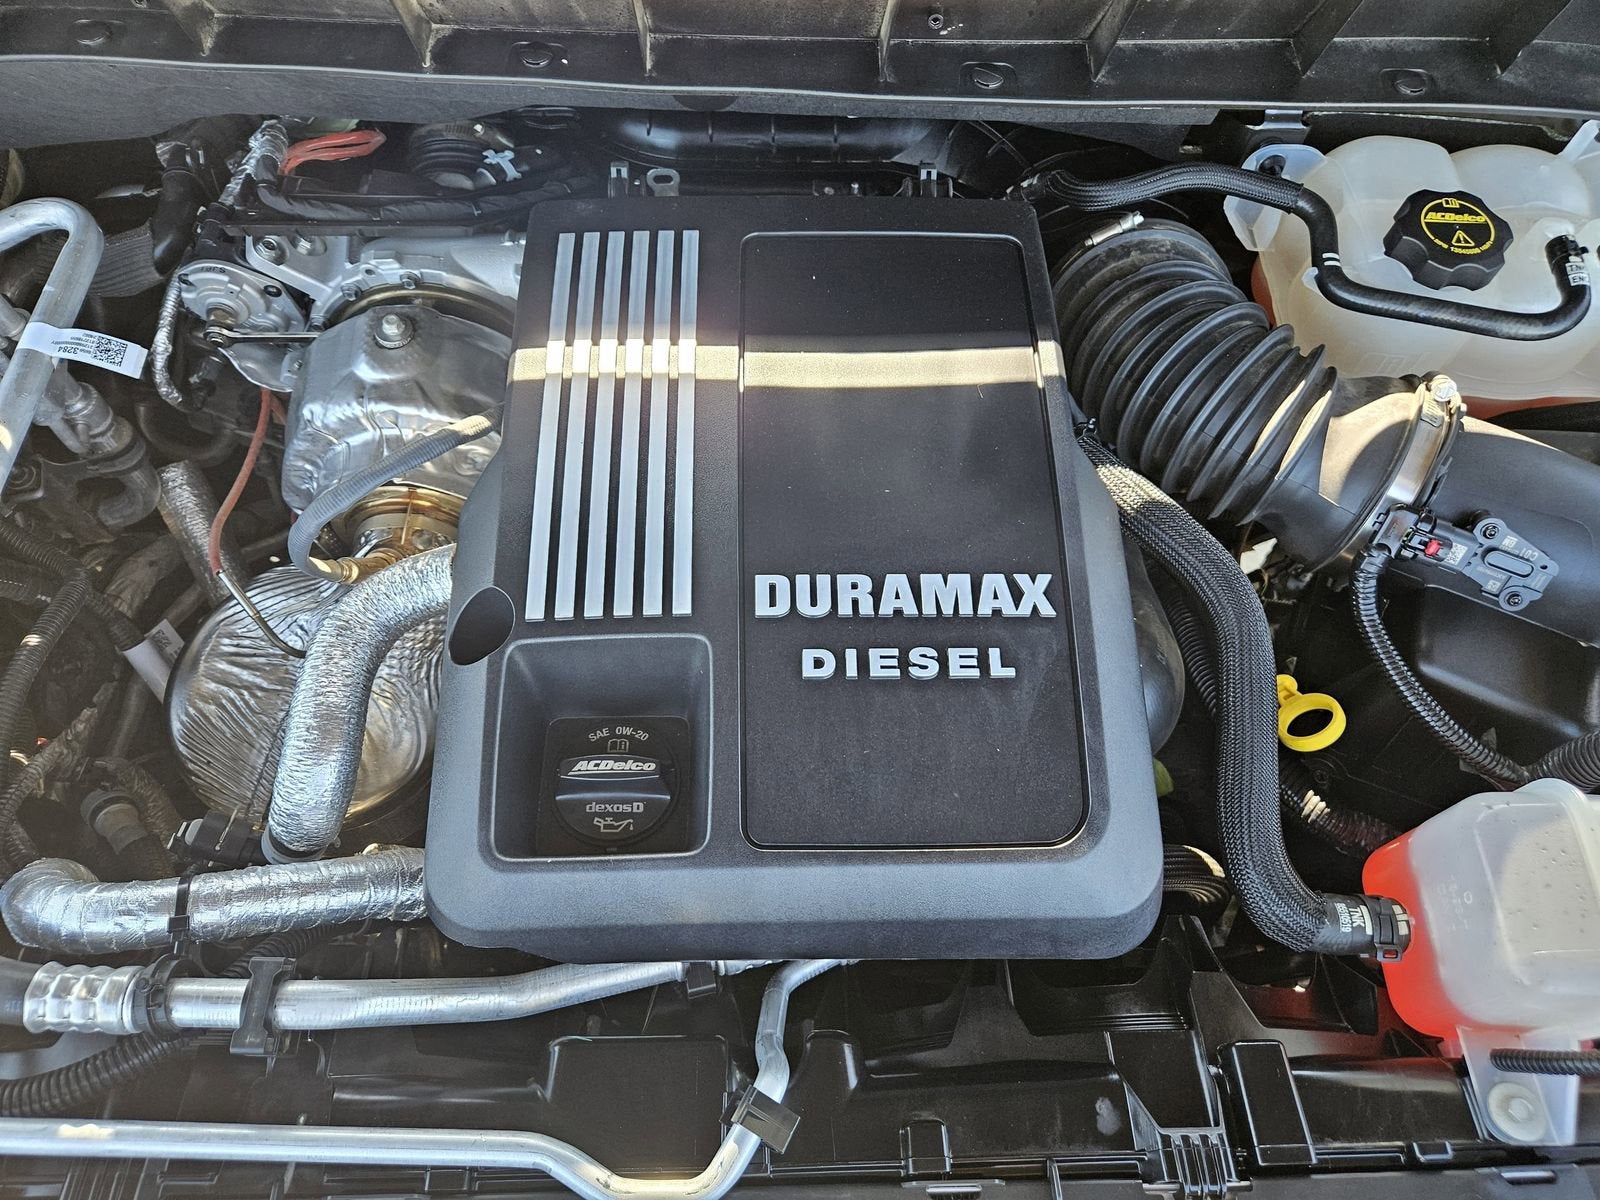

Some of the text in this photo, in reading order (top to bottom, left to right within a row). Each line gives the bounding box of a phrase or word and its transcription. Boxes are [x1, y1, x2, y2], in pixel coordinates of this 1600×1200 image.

[1425, 212, 1487, 222] ACDelco
[57, 345, 80, 355] 3284
[754, 573, 1057, 619] DURAMAX
[801, 647, 1017, 680] DIESEL
[588, 726, 649, 742] SAE 0W-20
[572, 759, 656, 771] ACDelco
[1348, 906, 1365, 928] TNK
